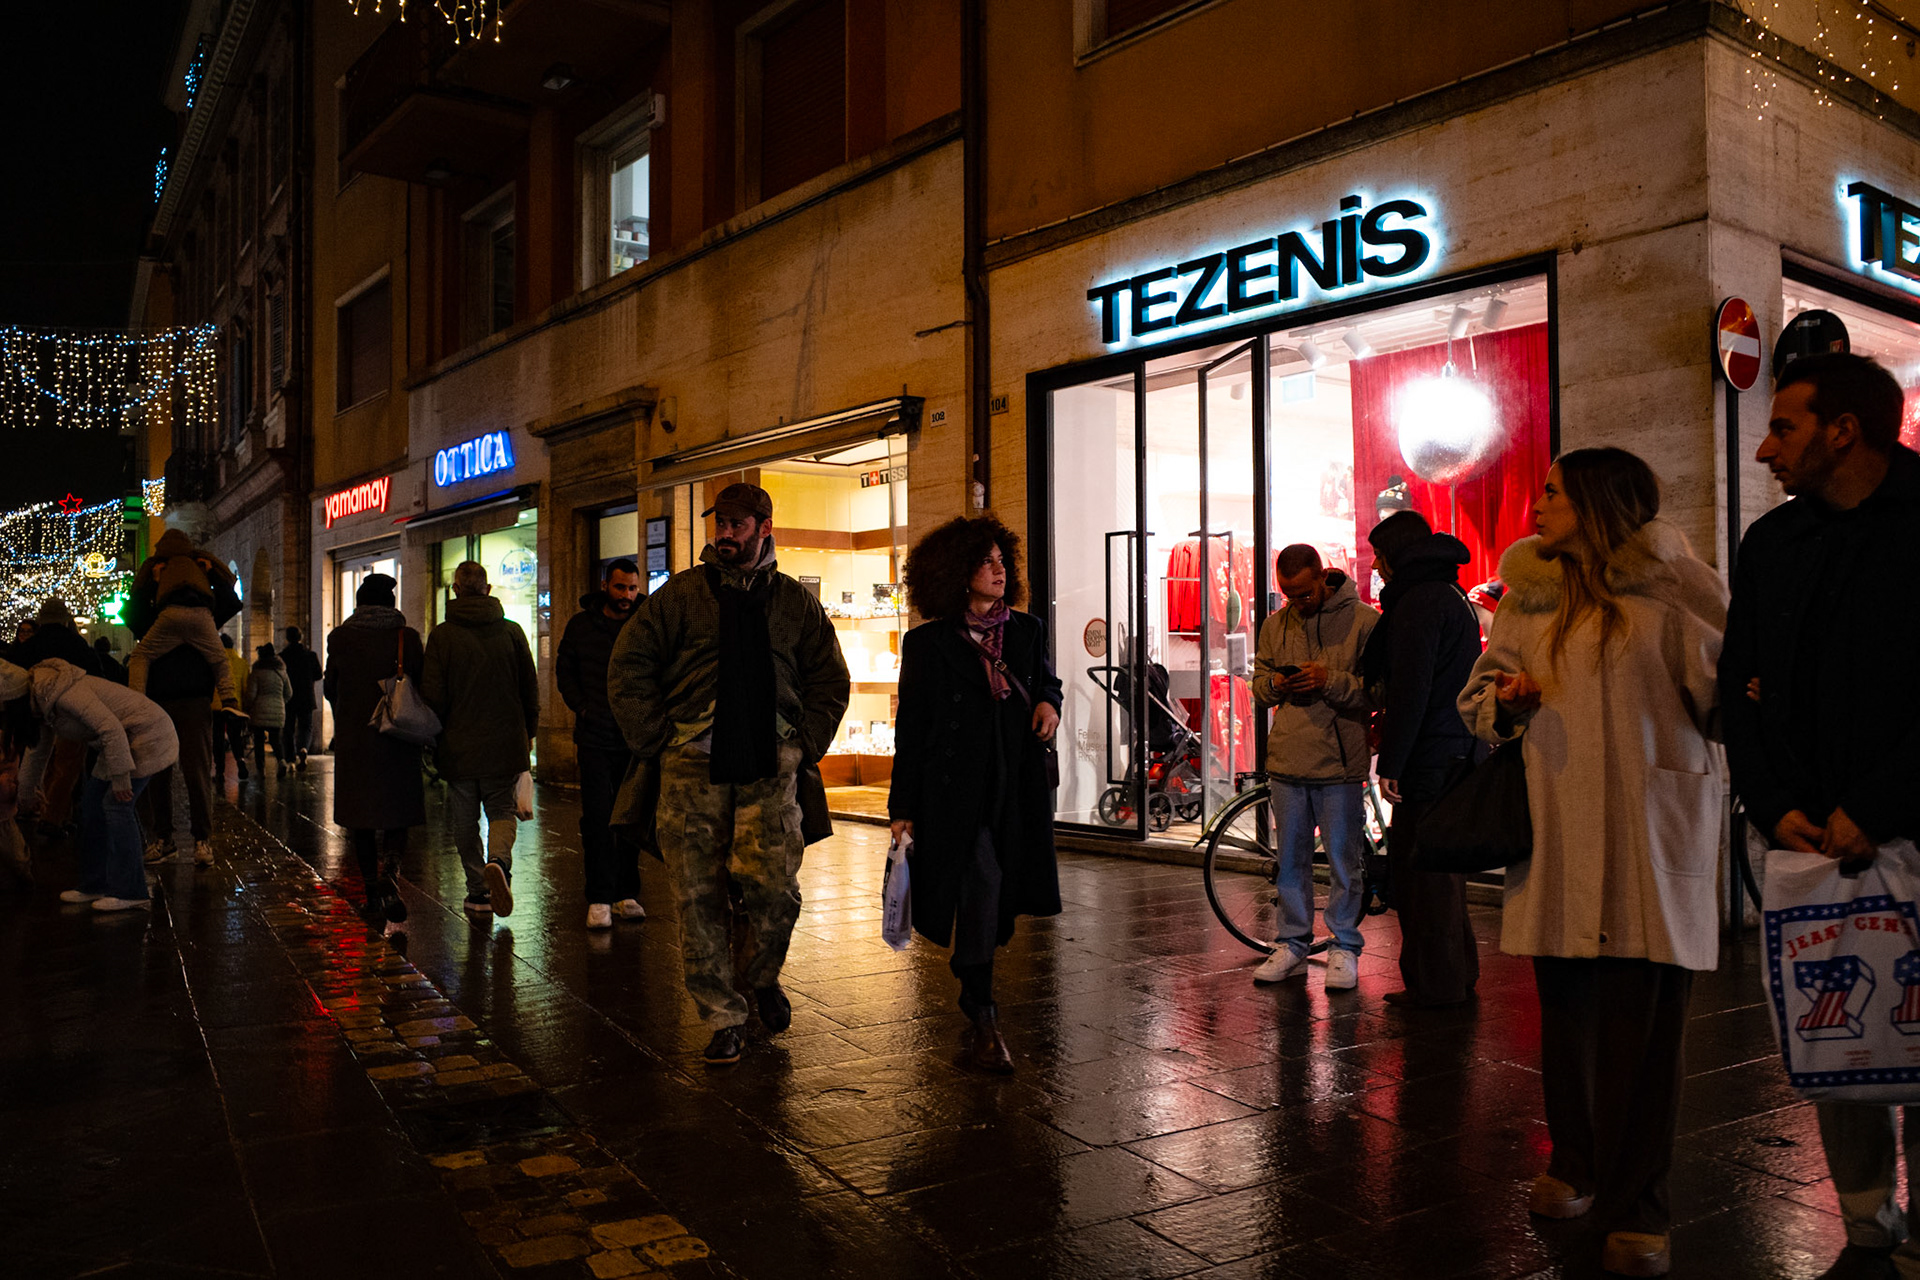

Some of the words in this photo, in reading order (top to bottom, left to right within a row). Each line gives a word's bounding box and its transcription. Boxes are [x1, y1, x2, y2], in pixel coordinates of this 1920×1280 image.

[1848, 181, 1920, 281] TE
[932, 411, 945, 422] 102
[991, 397, 1006, 411] 104
[435, 430, 510, 486] OTTICA
[325, 476, 389, 528] yamamay
